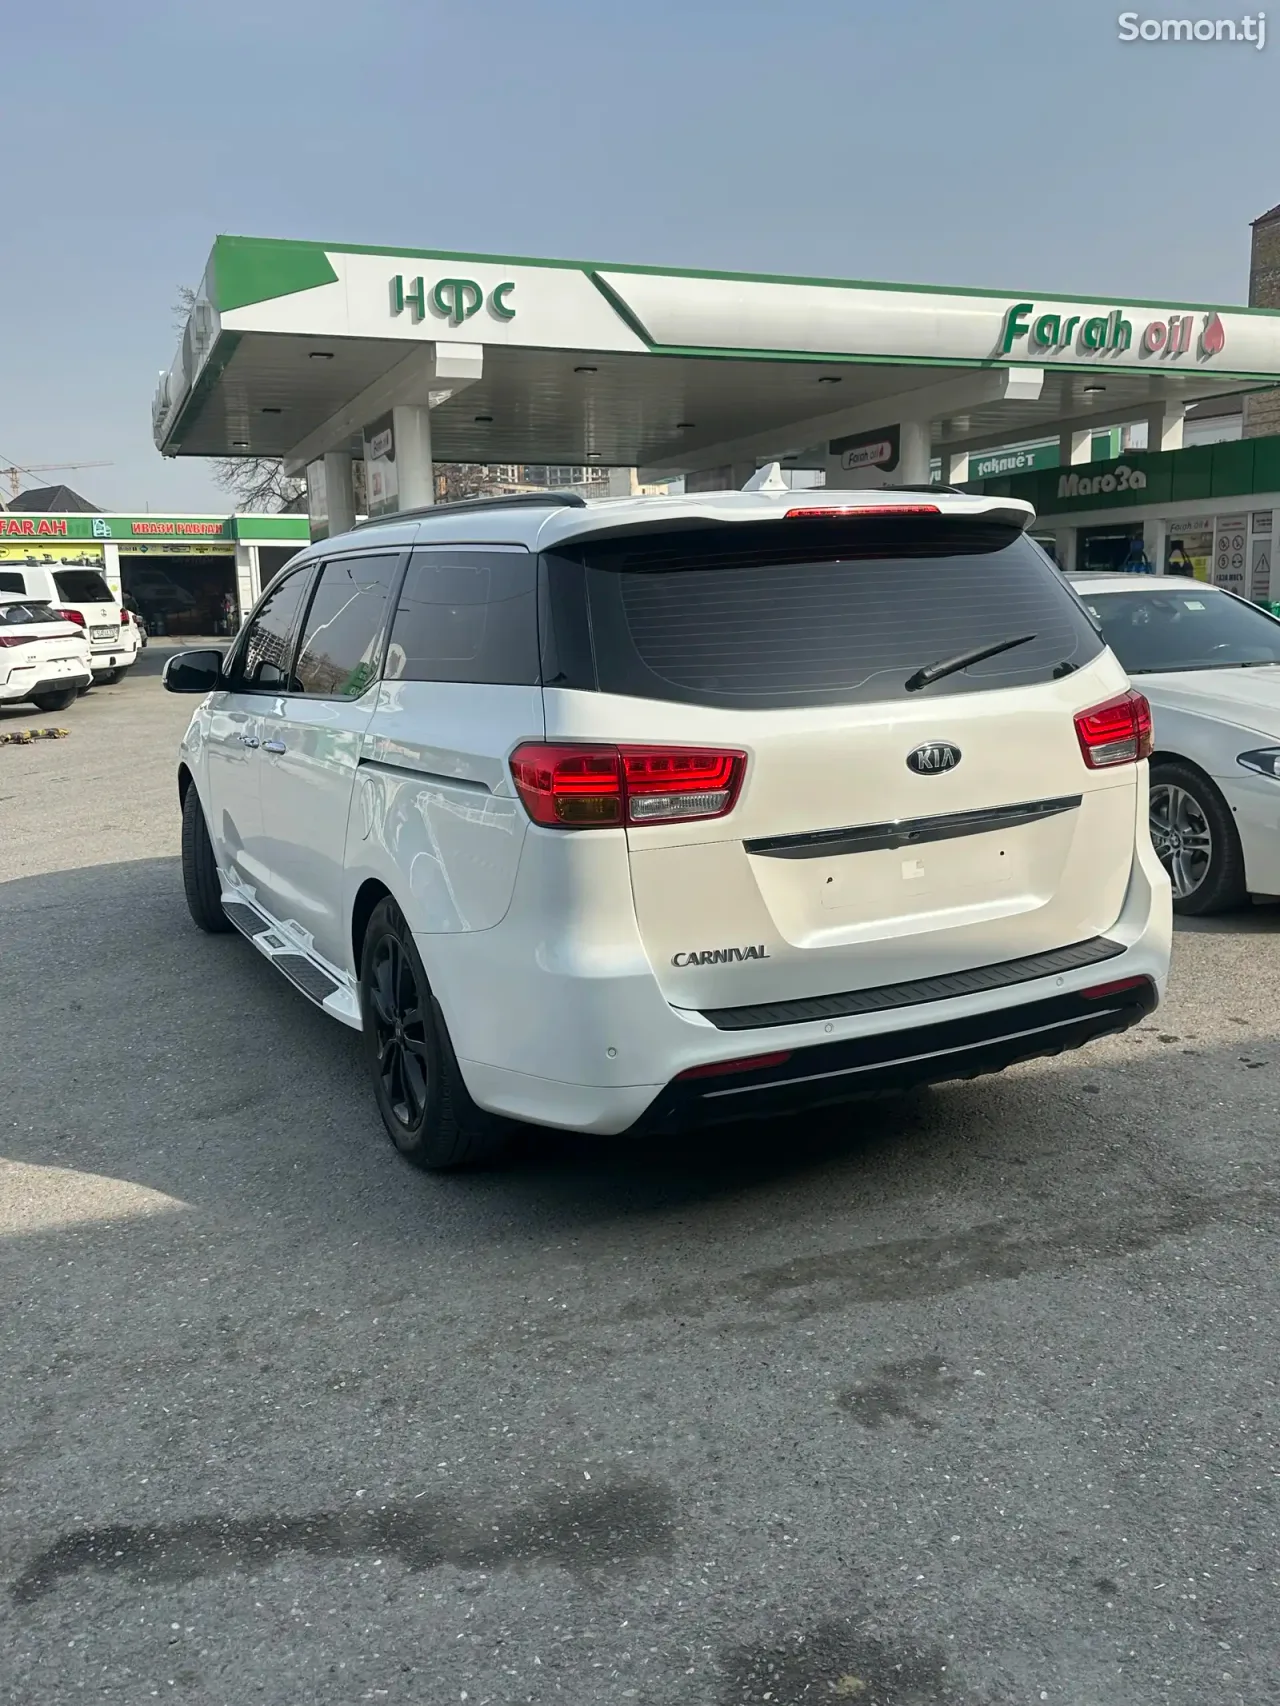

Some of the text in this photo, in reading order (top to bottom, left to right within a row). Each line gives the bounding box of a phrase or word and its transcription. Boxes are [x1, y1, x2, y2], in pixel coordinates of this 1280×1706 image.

[393, 275, 516, 324] НФС
[1002, 303, 1194, 354] Farah oil
[917, 747, 955, 770] KIA
[671, 944, 771, 968] CARNIVAL
